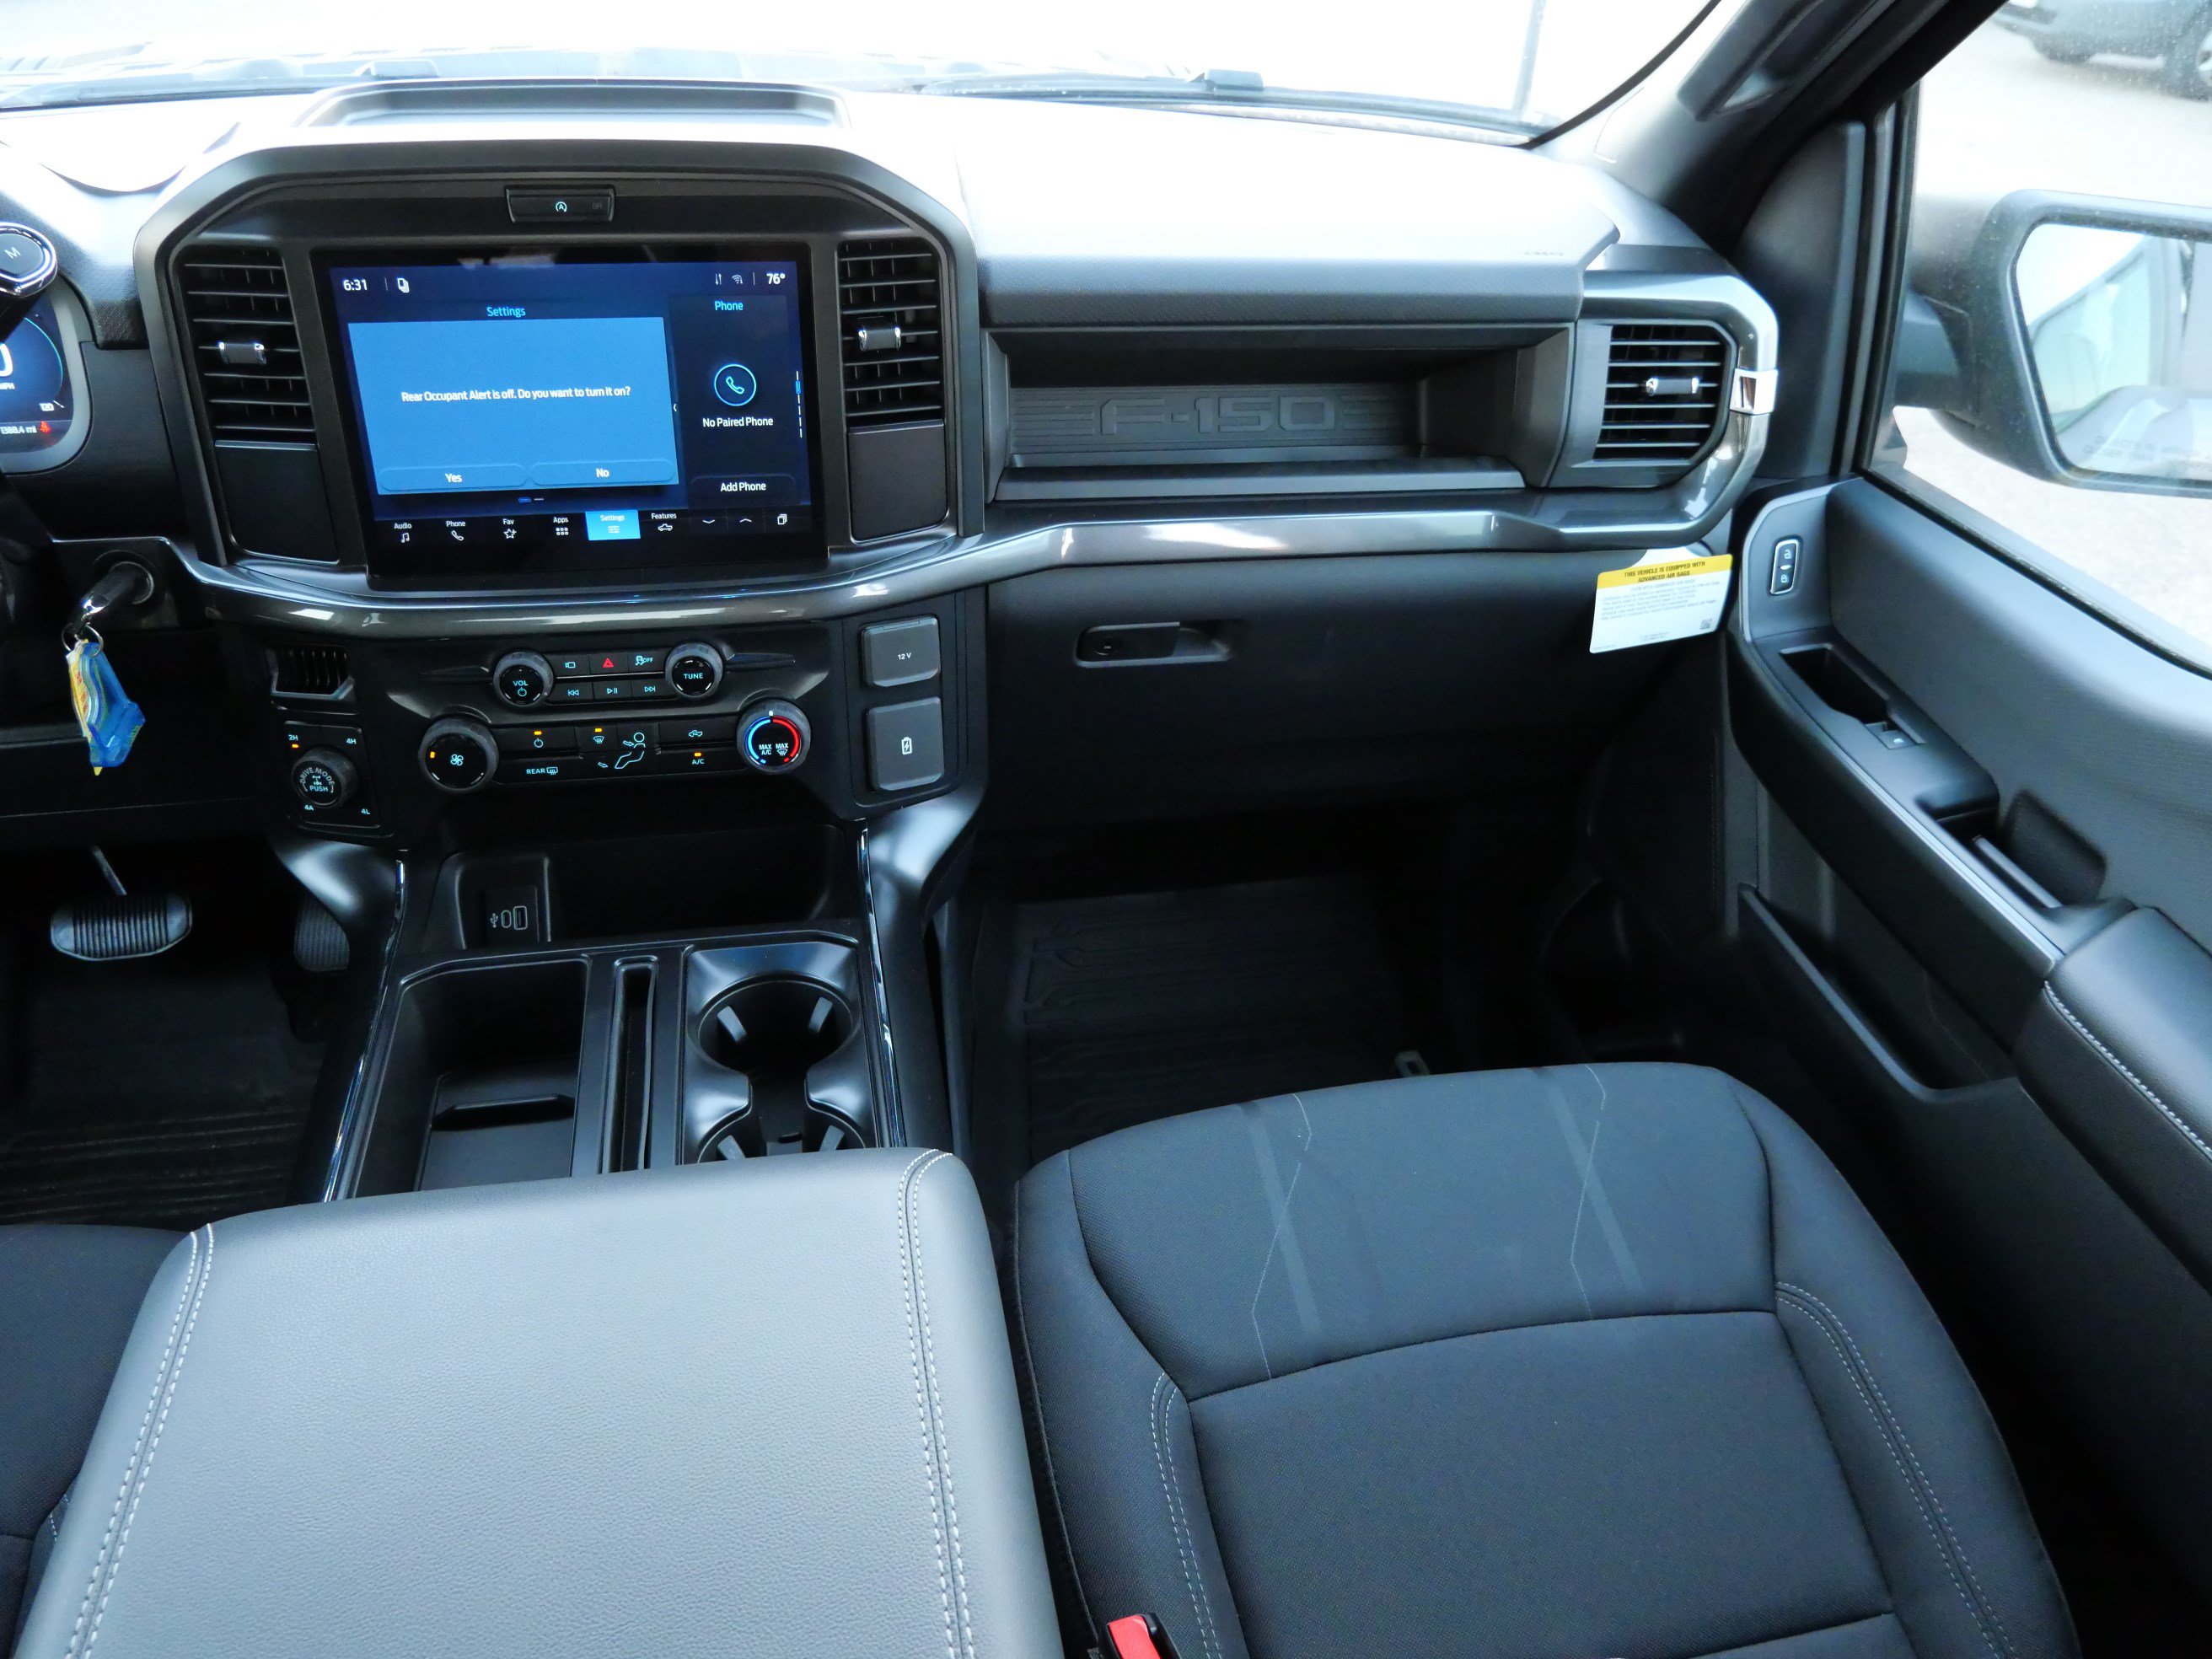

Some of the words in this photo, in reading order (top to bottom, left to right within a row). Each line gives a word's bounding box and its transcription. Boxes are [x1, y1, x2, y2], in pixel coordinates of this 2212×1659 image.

[4, 246, 21, 259] M
[766, 272, 786, 284] 76°
[343, 279, 368, 291] 6:31
[714, 300, 744, 311] Phone
[486, 306, 526, 318] Settings
[401, 391, 422, 402] Rear
[423, 390, 468, 403] Occupant
[469, 389, 491, 400] Alert
[492, 389, 501, 400] is
[502, 389, 517, 400] off.
[518, 389, 531, 399] Do
[532, 389, 549, 400] you
[550, 388, 573, 398] want
[574, 387, 584, 397] to
[585, 387, 604, 397] turn
[605, 386, 612, 396] it
[614, 385, 631, 396] on?
[702, 417, 715, 427] No
[717, 416, 744, 427] Paired
[745, 416, 774, 427] Phone
[1100, 396, 1335, 436] F-150
[444, 473, 463, 483] Yes
[595, 468, 609, 478] No
[720, 482, 738, 491] Add
[738, 481, 766, 491] Phone
[1636, 566, 1658, 576] VEHICLE
[1665, 562, 1691, 572] EQUIPPED
[1637, 574, 1666, 583] ADVANCED
[299, 766, 314, 784] DRIVE
[314, 767, 336, 786] MODE
